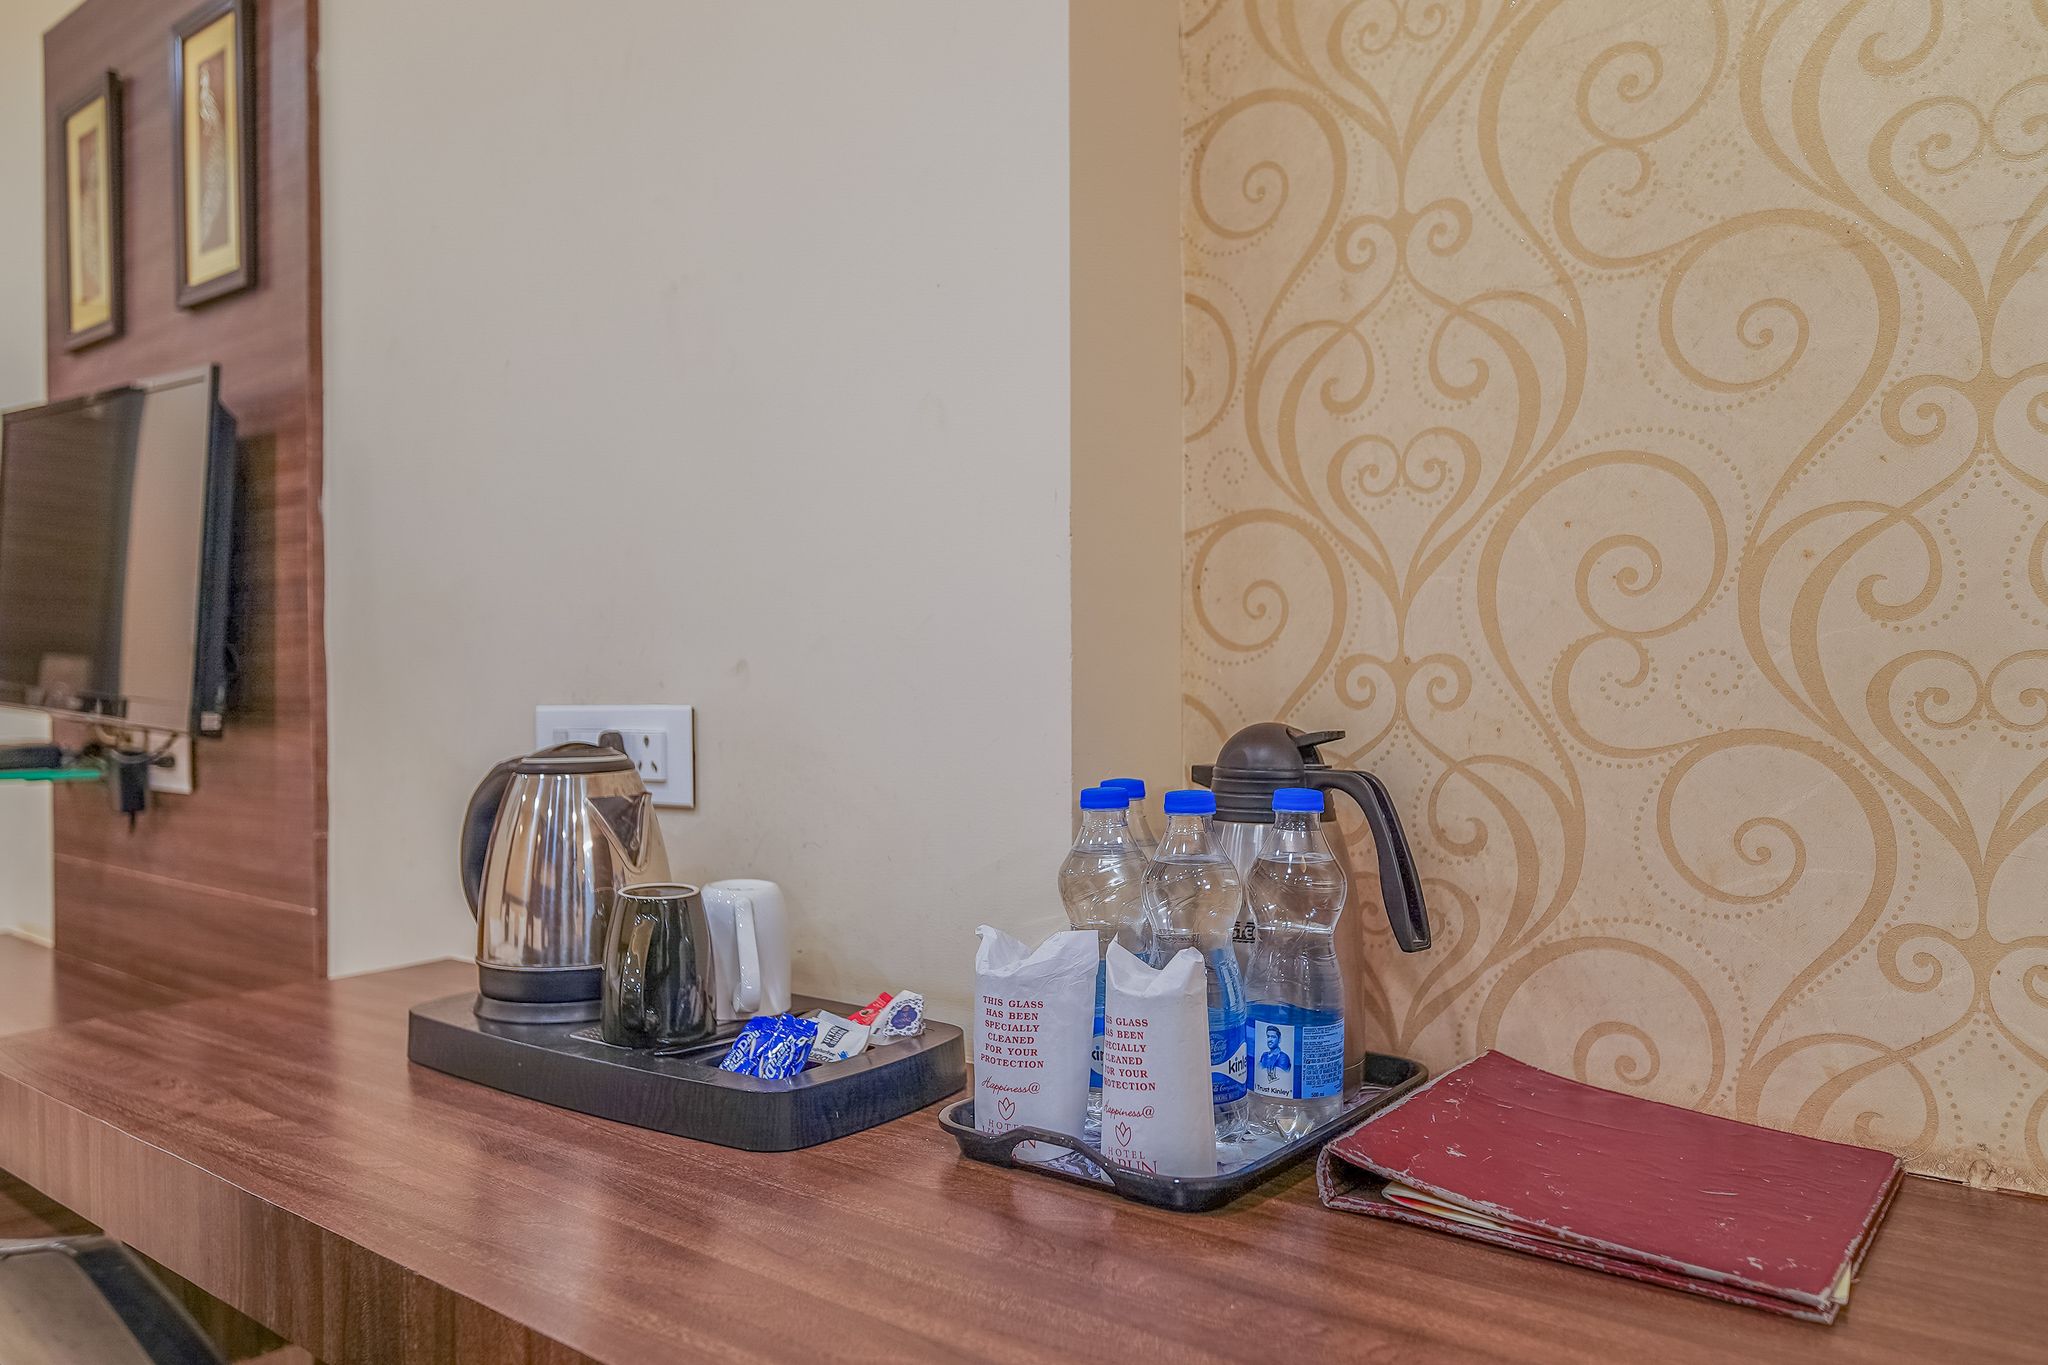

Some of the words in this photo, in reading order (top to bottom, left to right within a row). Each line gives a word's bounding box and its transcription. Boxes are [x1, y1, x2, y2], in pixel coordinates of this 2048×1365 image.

[983, 995, 1003, 1007] THIS
[1008, 1000, 1044, 1009] GLASS
[986, 1008, 1004, 1019] HAS
[1008, 1012, 1039, 1021] BEEN
[984, 1019, 1040, 1033] SPECIALLY
[1115, 1017, 1149, 1028] GLASS
[987, 1032, 1035, 1045] CLEANED
[1117, 1030, 1145, 1040] BEEN
[985, 1043, 1003, 1055] FOR
[1007, 1047, 1038, 1057] YOUR
[980, 1053, 1045, 1069] PROTECTION
[1118, 1068, 1149, 1079] YOUR
[988, 1118, 1024, 1131] HOTE
[1108, 1146, 1146, 1161] HOTEL
